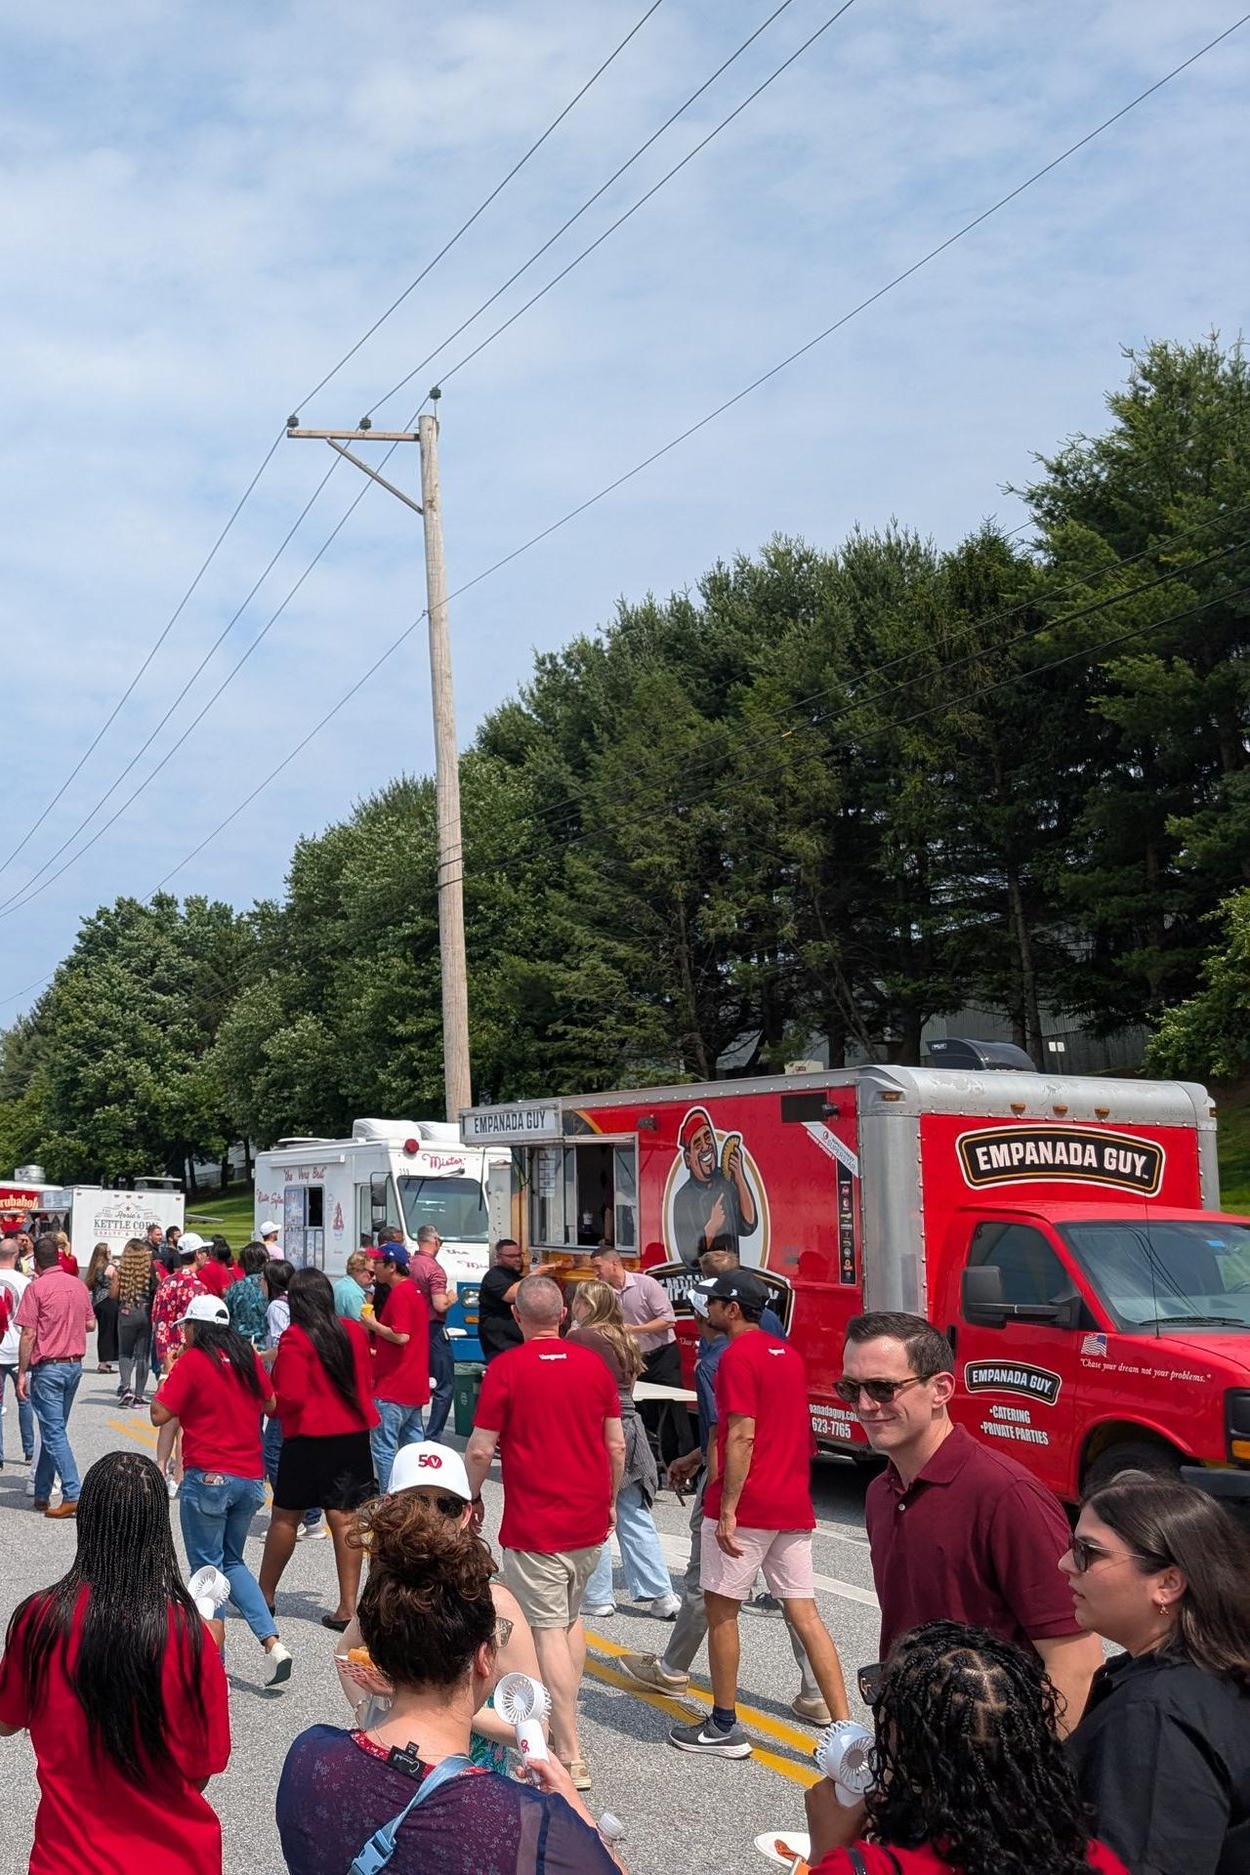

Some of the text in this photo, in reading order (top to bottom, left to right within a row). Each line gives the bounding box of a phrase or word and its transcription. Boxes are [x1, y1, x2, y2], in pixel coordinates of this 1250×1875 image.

[474, 1110, 546, 1134] EMPANADA GUY
[975, 1141, 1149, 1178] EMPANADA GUY
[94, 1219, 154, 1230] KETTLE COR
[972, 1368, 1053, 1393] EMPANADA GUY
[1102, 1362, 1118, 1372] your
[1118, 1362, 1139, 1374] dream
[1141, 1367, 1152, 1376] not
[1153, 1368, 1170, 1379] your
[811, 1416, 852, 1439] 623-7765
[1016, 1427, 1049, 1446] PARTIES
